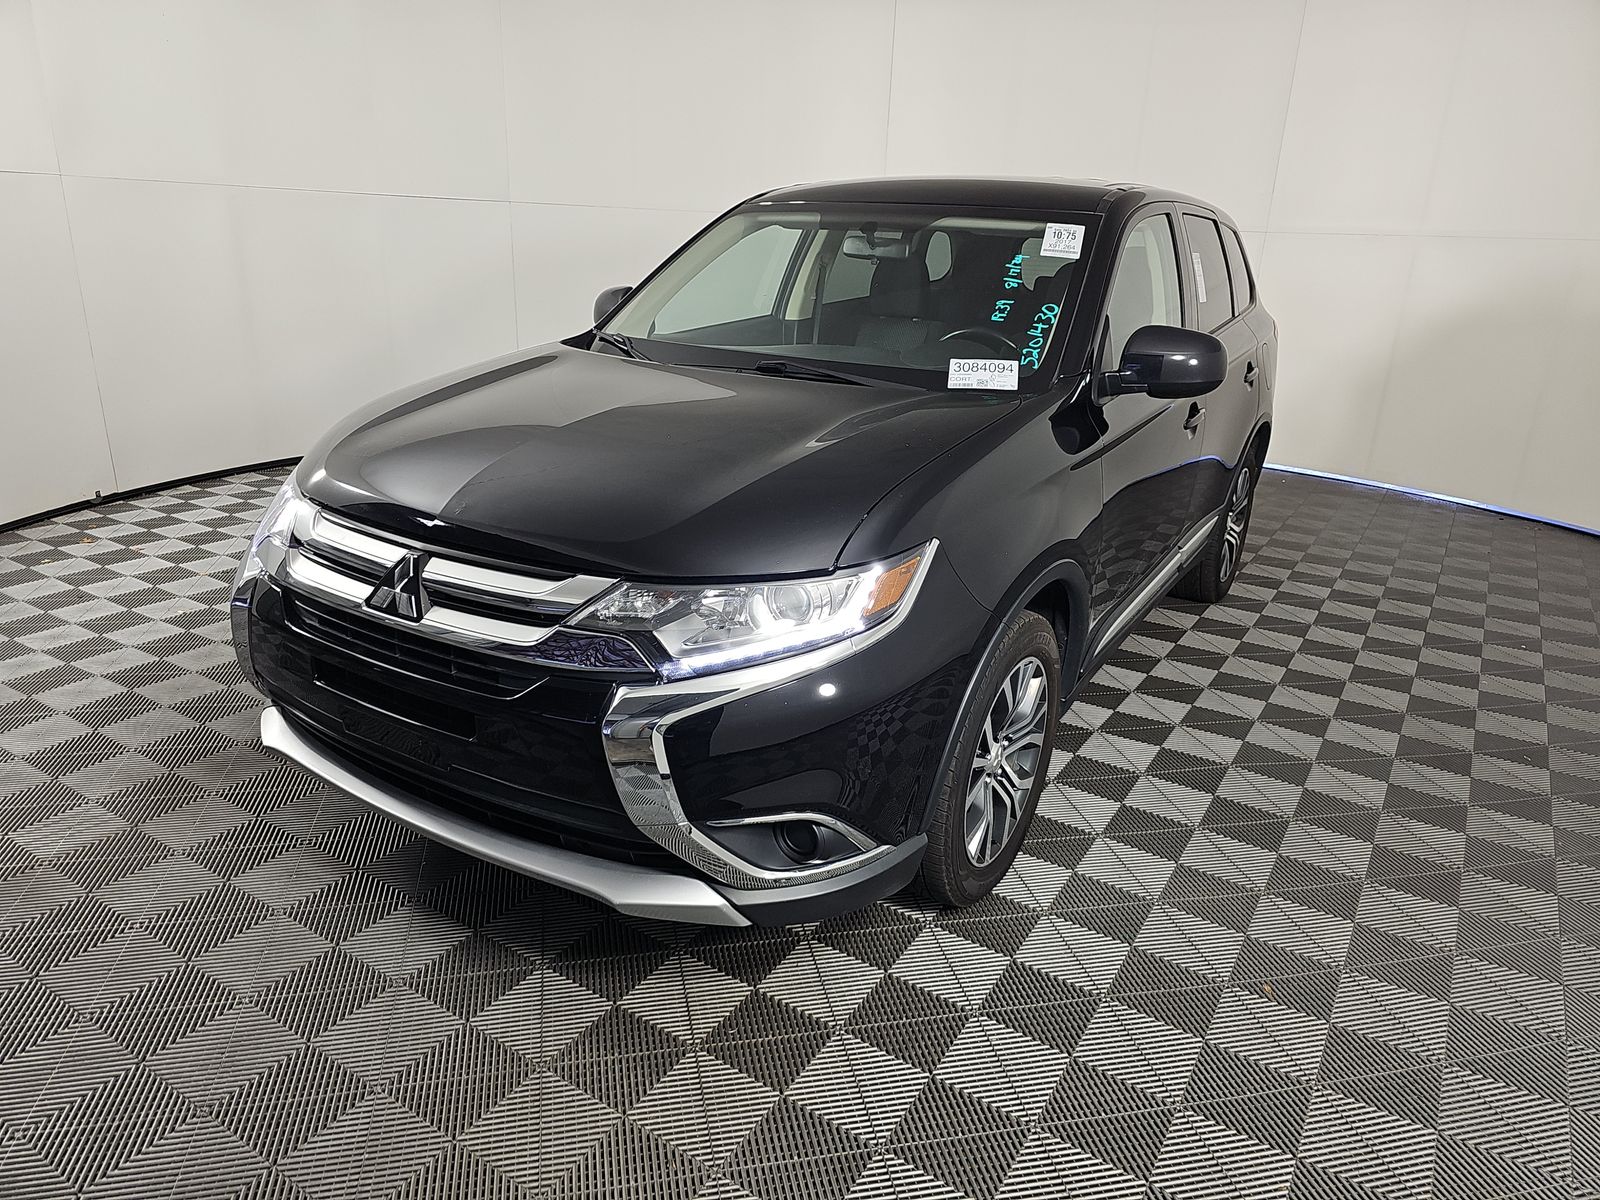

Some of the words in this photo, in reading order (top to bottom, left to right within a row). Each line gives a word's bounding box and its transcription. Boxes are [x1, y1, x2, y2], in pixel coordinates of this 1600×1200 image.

[1053, 231, 1077, 240] 10:75
[1020, 303, 1059, 369] 5201430
[953, 361, 1014, 374] 3084094
